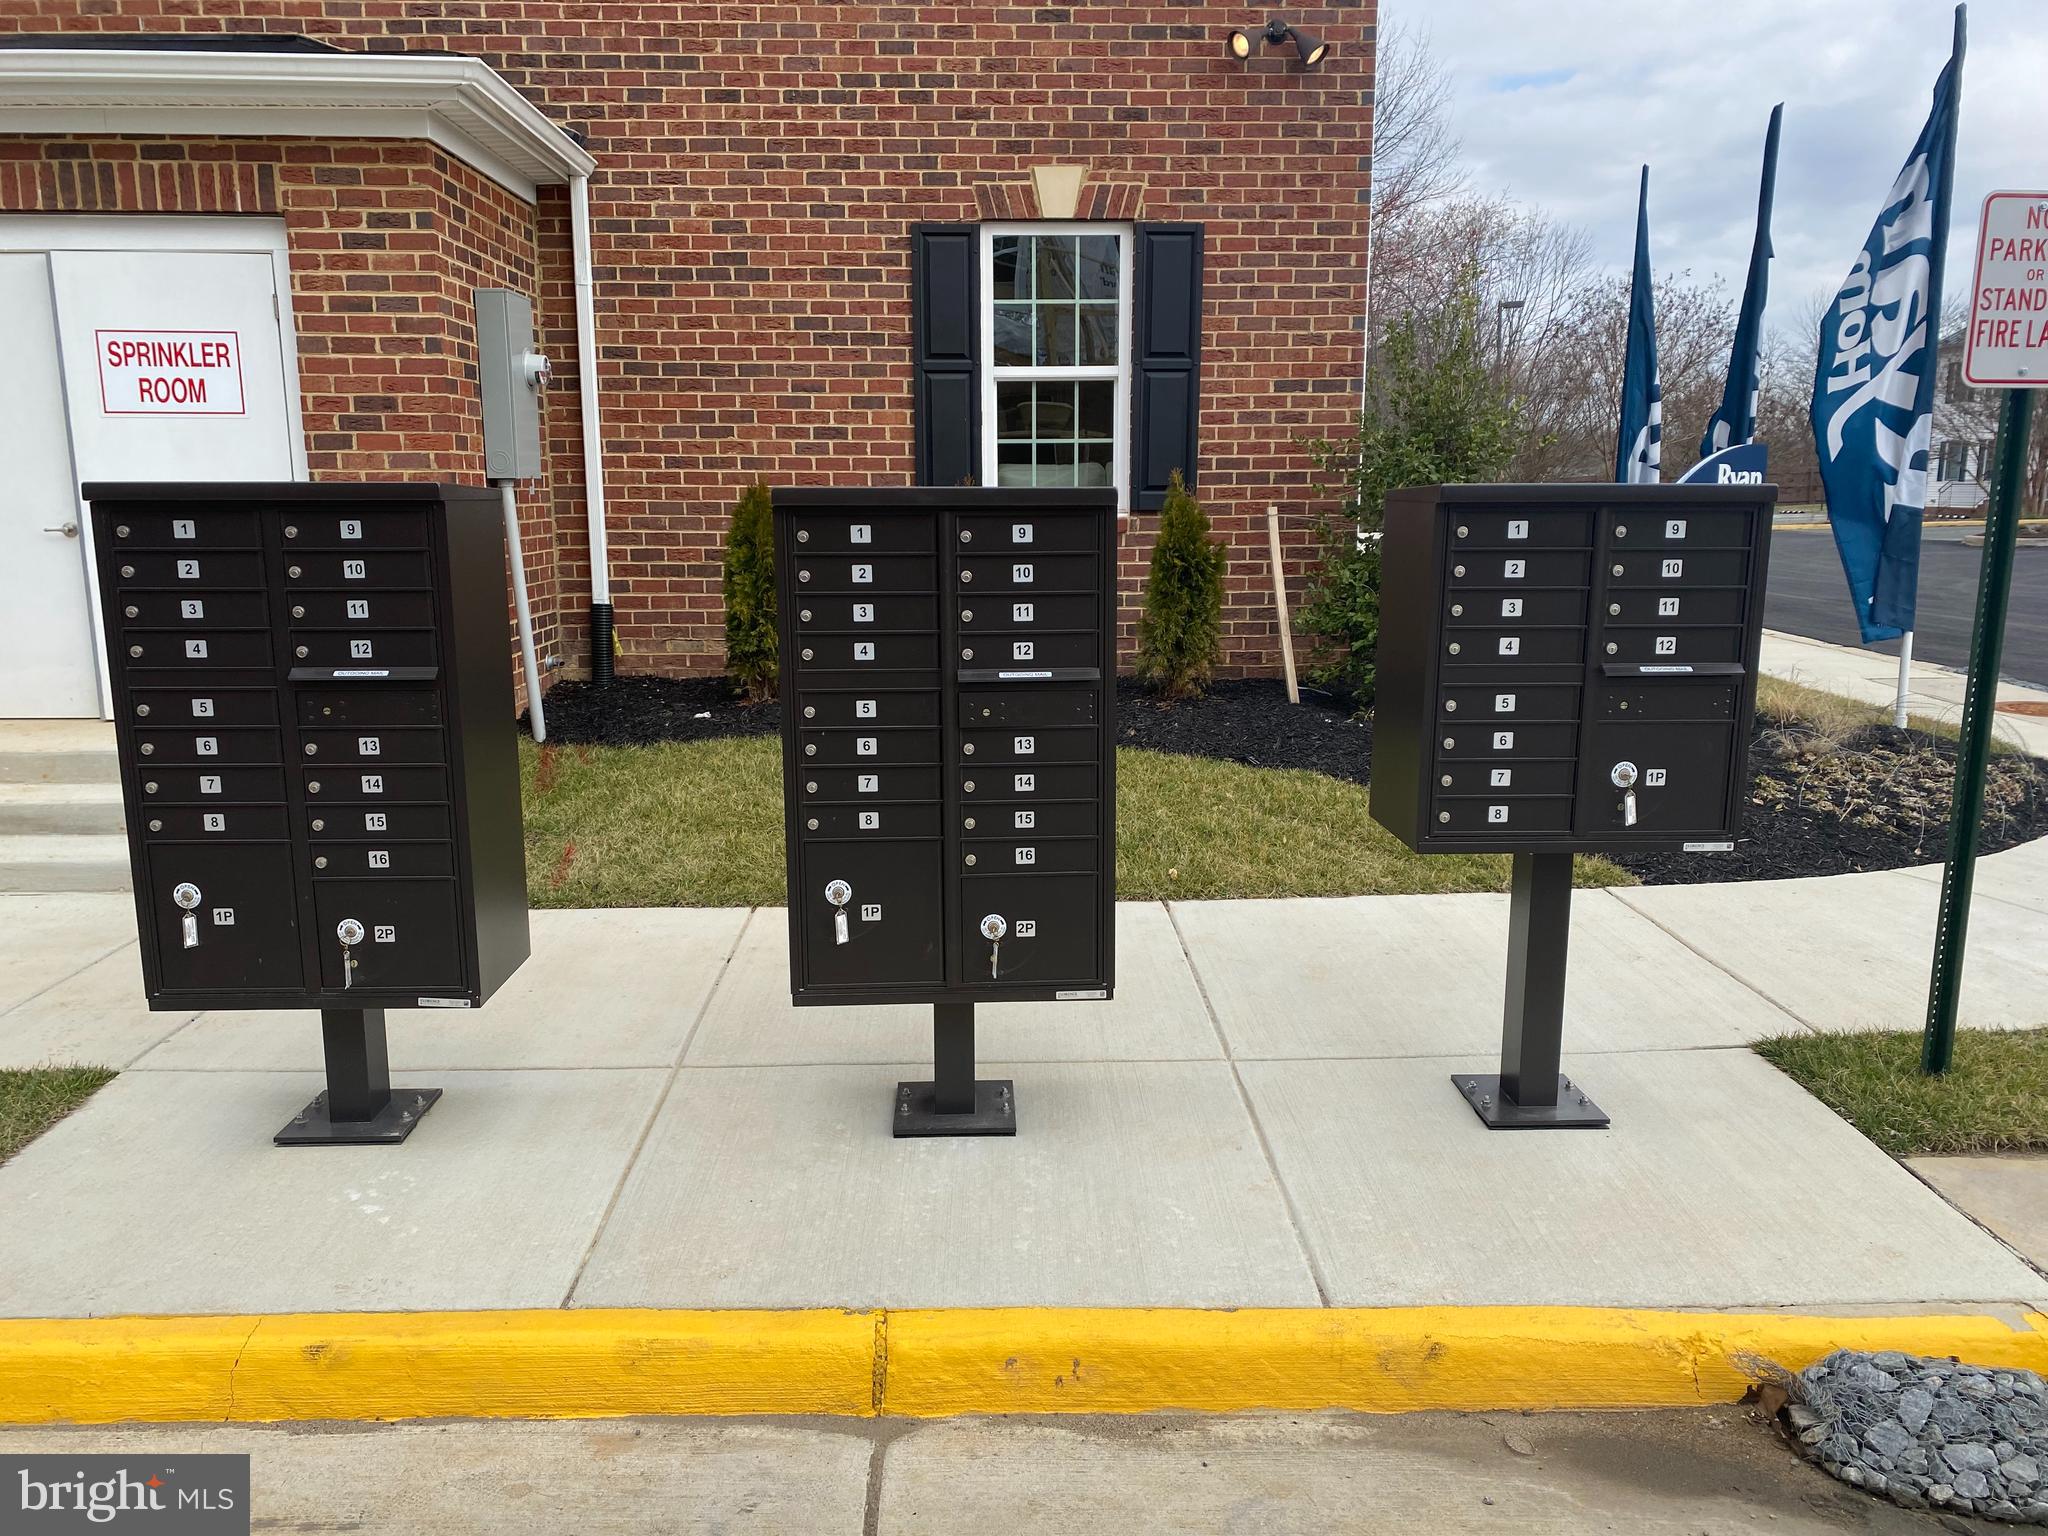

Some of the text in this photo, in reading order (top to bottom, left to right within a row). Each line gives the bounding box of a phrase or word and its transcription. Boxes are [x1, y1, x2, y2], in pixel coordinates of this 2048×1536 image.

[2027, 269, 2045, 281] OR
[1975, 320, 2022, 348] FIRE
[107, 340, 231, 368] SPRINKLER
[138, 377, 206, 403] ROOM
[1718, 463, 1763, 484] Ryan
[180, 522, 188, 535] 1
[346, 522, 356, 536] 9
[856, 526, 863, 539] 1
[1018, 526, 1026, 539] 9
[1514, 522, 1521, 536] 1
[1672, 522, 1680, 535] 9
[184, 562, 193, 575] 2
[346, 562, 363, 575] 10
[858, 566, 867, 579] 2
[1014, 565, 1031, 579] 10
[1510, 562, 1519, 575] 2
[1664, 561, 1680, 574] 10
[188, 602, 197, 615] 3
[349, 602, 365, 615] 11
[859, 605, 867, 618] 3
[1014, 604, 1030, 618] 11
[1508, 601, 1516, 614] 3
[1661, 599, 1675, 612] 11
[192, 641, 201, 655] 4
[352, 641, 370, 655] 12
[859, 644, 869, 657] 4
[1014, 643, 1031, 656] 12
[1505, 639, 1513, 652] 4
[1658, 639, 1674, 651] 12
[199, 700, 208, 714] 5
[862, 701, 870, 714] 5
[1501, 696, 1509, 709] 5
[203, 739, 212, 752] 6
[361, 739, 378, 752] 13
[862, 739, 871, 752] 6
[1015, 737, 1032, 750] 13
[1499, 734, 1507, 746] 6
[206, 777, 215, 790] 7
[364, 777, 381, 790] 14
[864, 776, 872, 789] 7
[1016, 775, 1033, 788] 14
[1497, 771, 1505, 783] 7
[1647, 771, 1665, 783] 1P
[865, 813, 873, 826] 8
[1016, 812, 1033, 825] 15
[1494, 807, 1502, 820] 8
[210, 815, 219, 828] 8
[367, 815, 385, 828] 15
[370, 852, 388, 865] 16
[1017, 848, 1033, 861] 16
[214, 910, 233, 922] 1P
[862, 905, 880, 918] 1P
[375, 927, 394, 939] 2P
[1016, 921, 1034, 934] 2P
